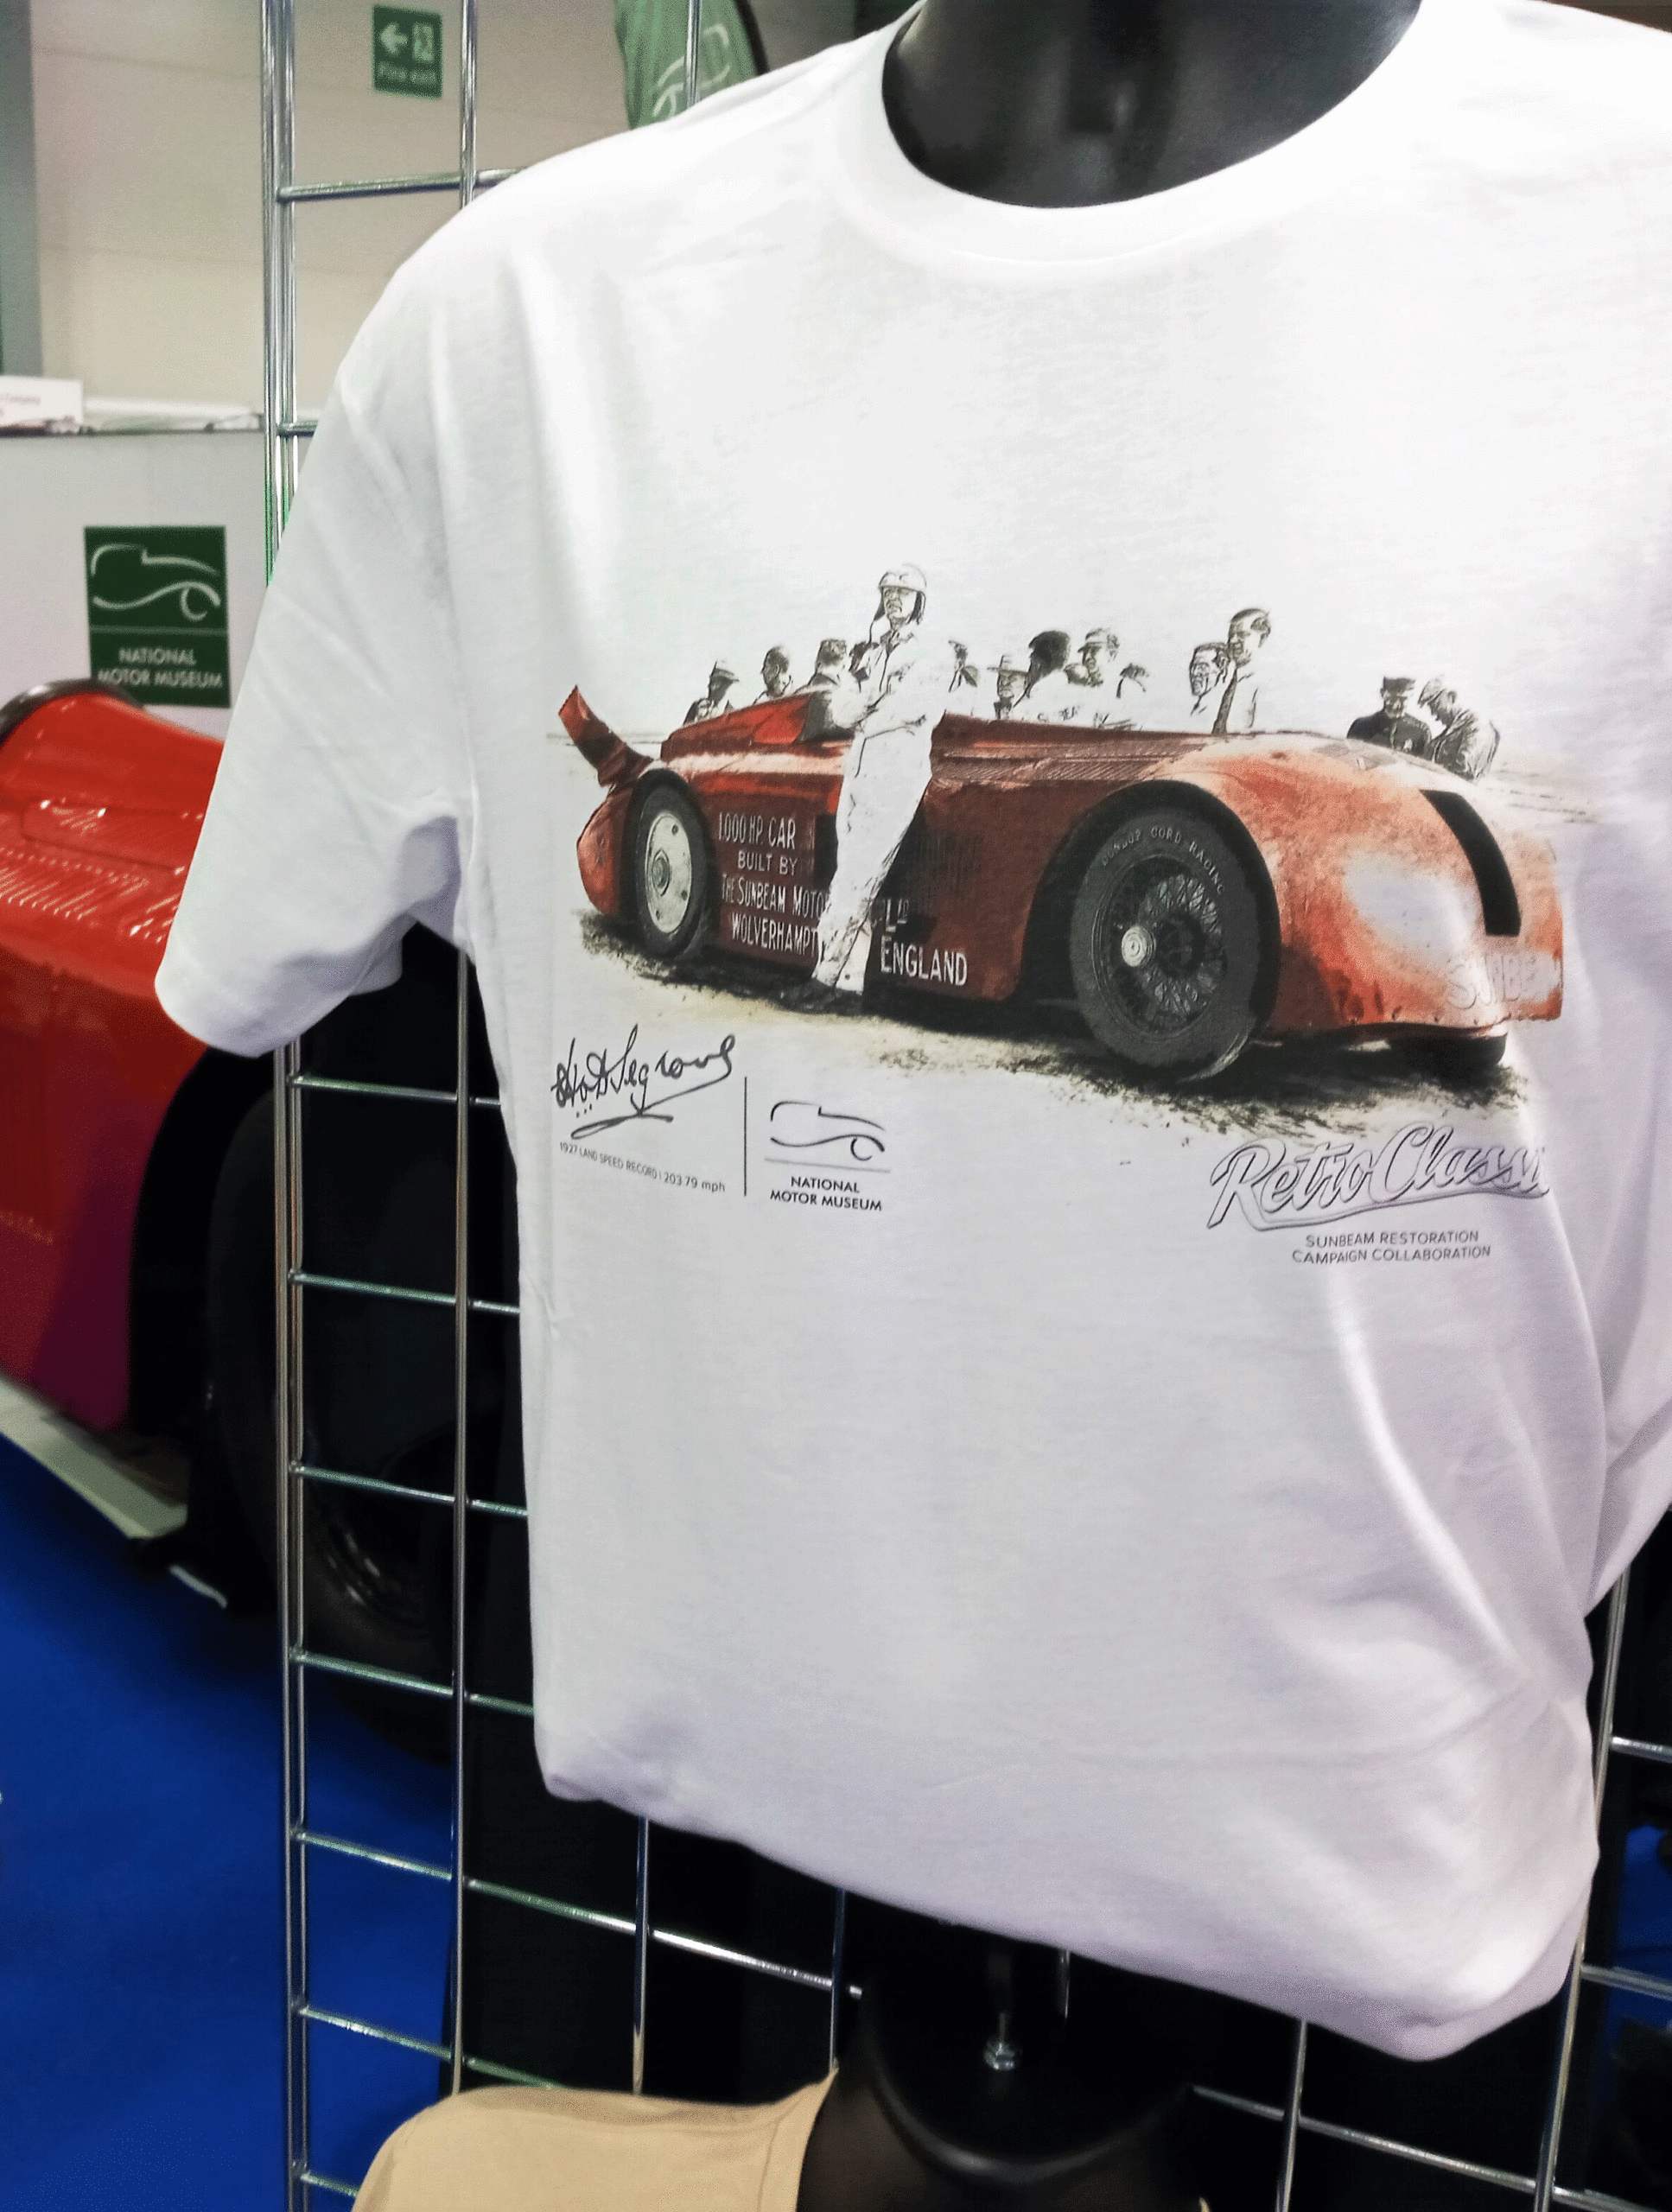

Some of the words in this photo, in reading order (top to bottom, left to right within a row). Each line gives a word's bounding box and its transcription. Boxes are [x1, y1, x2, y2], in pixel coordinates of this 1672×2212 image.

[118, 648, 196, 664] NATIONAL
[98, 669, 150, 685] MOTOR
[155, 671, 222, 687] MUSEUM
[768, 817, 796, 849] CAR
[1151, 827, 1180, 843] CORD
[738, 849, 772, 872] BUILT
[779, 855, 798, 876] BY
[722, 874, 734, 903] THE
[737, 876, 786, 913] SUNBEAM
[731, 912, 819, 957] WOLVERHAMPT
[881, 936, 968, 986] ENGLAND
[560, 1141, 578, 1154] 1927
[580, 1147, 598, 1161] LAND
[600, 1154, 624, 1170] SPEED
[626, 1160, 658, 1180] RECORD
[702, 1181, 726, 1193] mph
[791, 1176, 861, 1193] NATIONAL
[770, 1190, 817, 1205] MOTOR
[821, 1195, 882, 1211] MUSEUM
[1306, 1232, 1375, 1248] SUNBEAM
[1380, 1230, 1479, 1245] RESTORATION
[1292, 1249, 1367, 1264] CAMPAIGN
[1372, 1246, 1491, 1262] COLLABORATION
